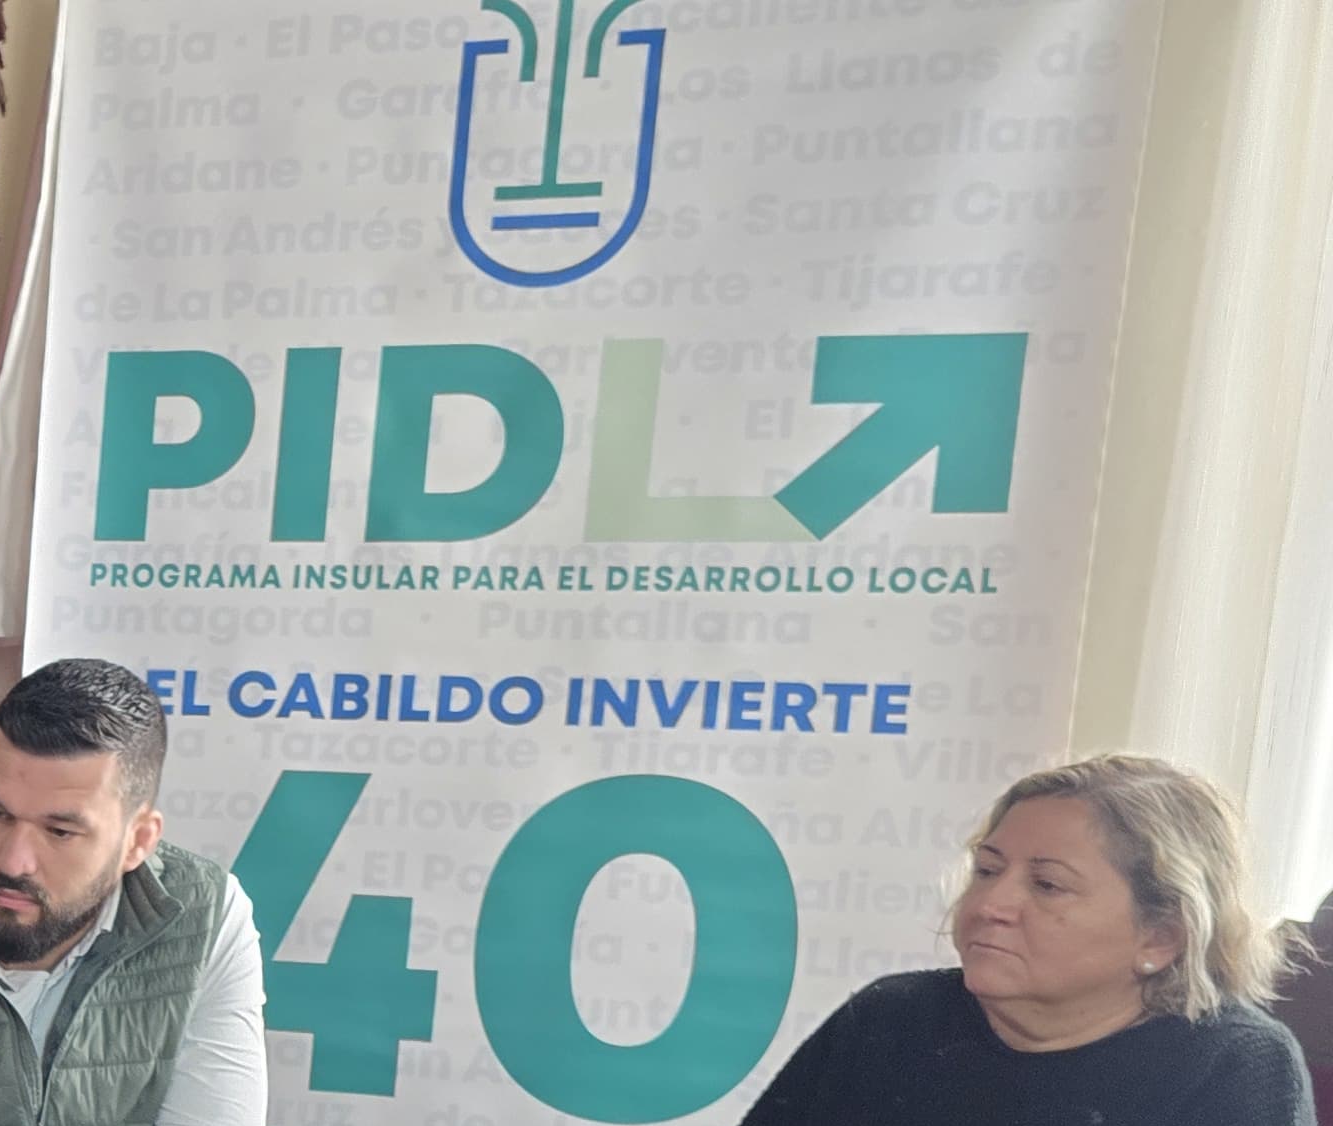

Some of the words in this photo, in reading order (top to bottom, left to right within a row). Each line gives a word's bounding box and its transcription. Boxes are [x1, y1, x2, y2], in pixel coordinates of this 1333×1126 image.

[96, 22, 217, 75] Baja
[265, 15, 312, 59] El
[329, 14, 469, 56] Paso
[91, 87, 261, 133] Palma
[784, 47, 1002, 95] Llanos
[1037, 30, 1123, 79] de
[85, 150, 303, 195] Aridane
[752, 107, 1119, 166] Puntallana
[111, 218, 213, 260] San
[223, 205, 425, 257] Andrés
[742, 188, 936, 237] Santa
[951, 180, 1107, 226] Cruz
[75, 283, 141, 324] de
[153, 282, 214, 324] La
[222, 277, 399, 320] Palma
[442, 264, 754, 314] Tazacorte
[799, 248, 1061, 311] Tijarafe
[744, 399, 795, 441] El
[90, 562, 283, 590] PROGRAMA
[291, 563, 442, 592] INSULAR
[451, 564, 545, 592] PARA
[556, 564, 595, 592] EL
[605, 564, 855, 595] DESARROLLO
[866, 565, 1000, 596] LOCAL
[51, 597, 373, 646] Puntagorda
[476, 600, 812, 645] Puntallana
[928, 603, 1053, 648] San
[145, 669, 212, 717] EL
[226, 670, 546, 727] CABILDO
[564, 677, 913, 736] INVIERTE
[253, 722, 541, 769] Tazacorte
